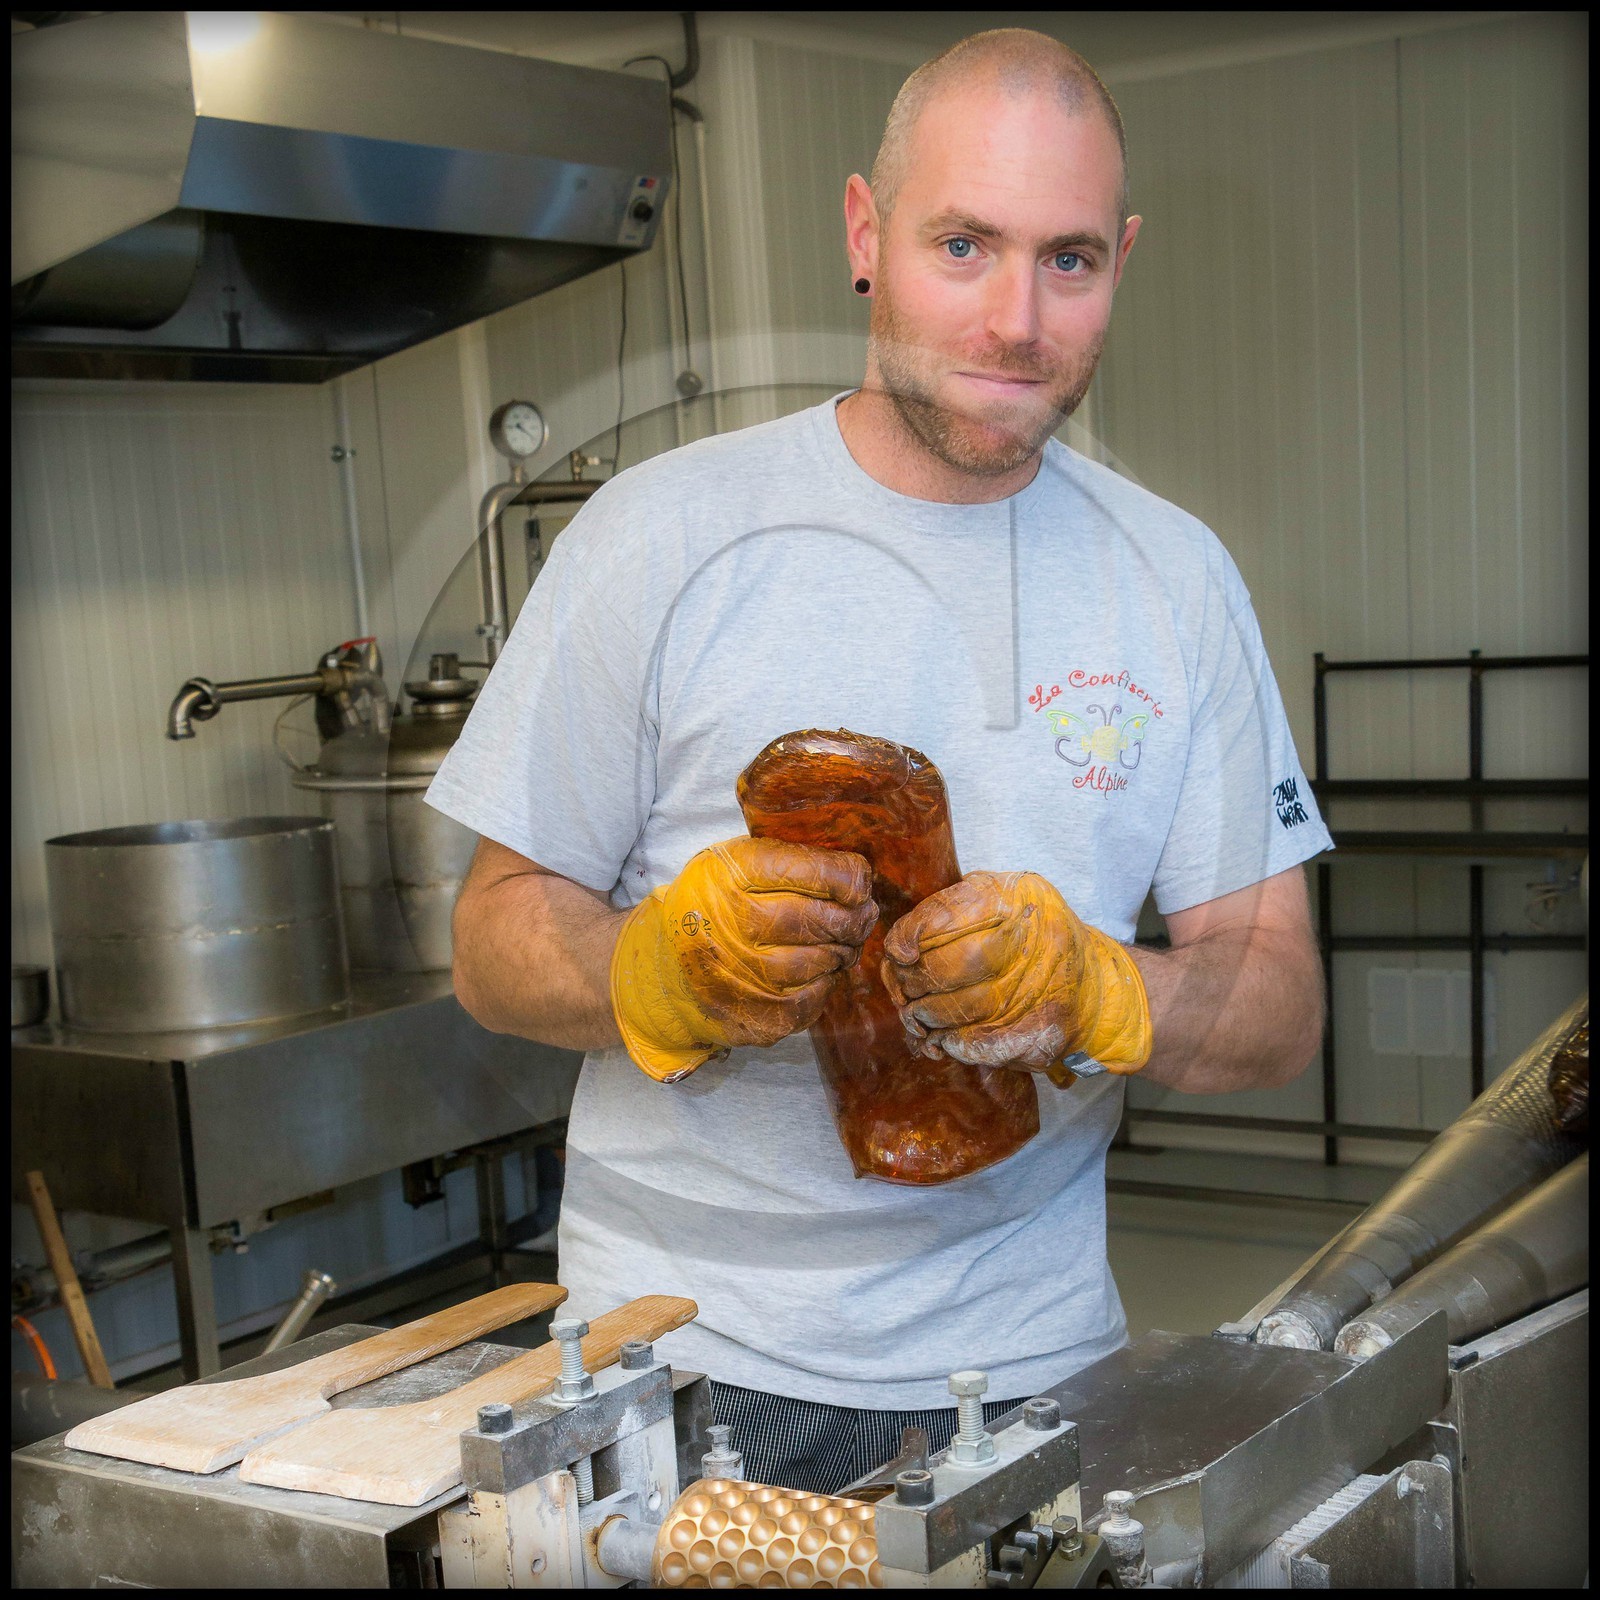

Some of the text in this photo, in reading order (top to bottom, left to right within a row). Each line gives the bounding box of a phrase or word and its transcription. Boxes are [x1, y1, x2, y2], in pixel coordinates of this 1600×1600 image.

[1028, 670, 1164, 719] La Confiserie
[1072, 766, 1128, 800] Alpine
